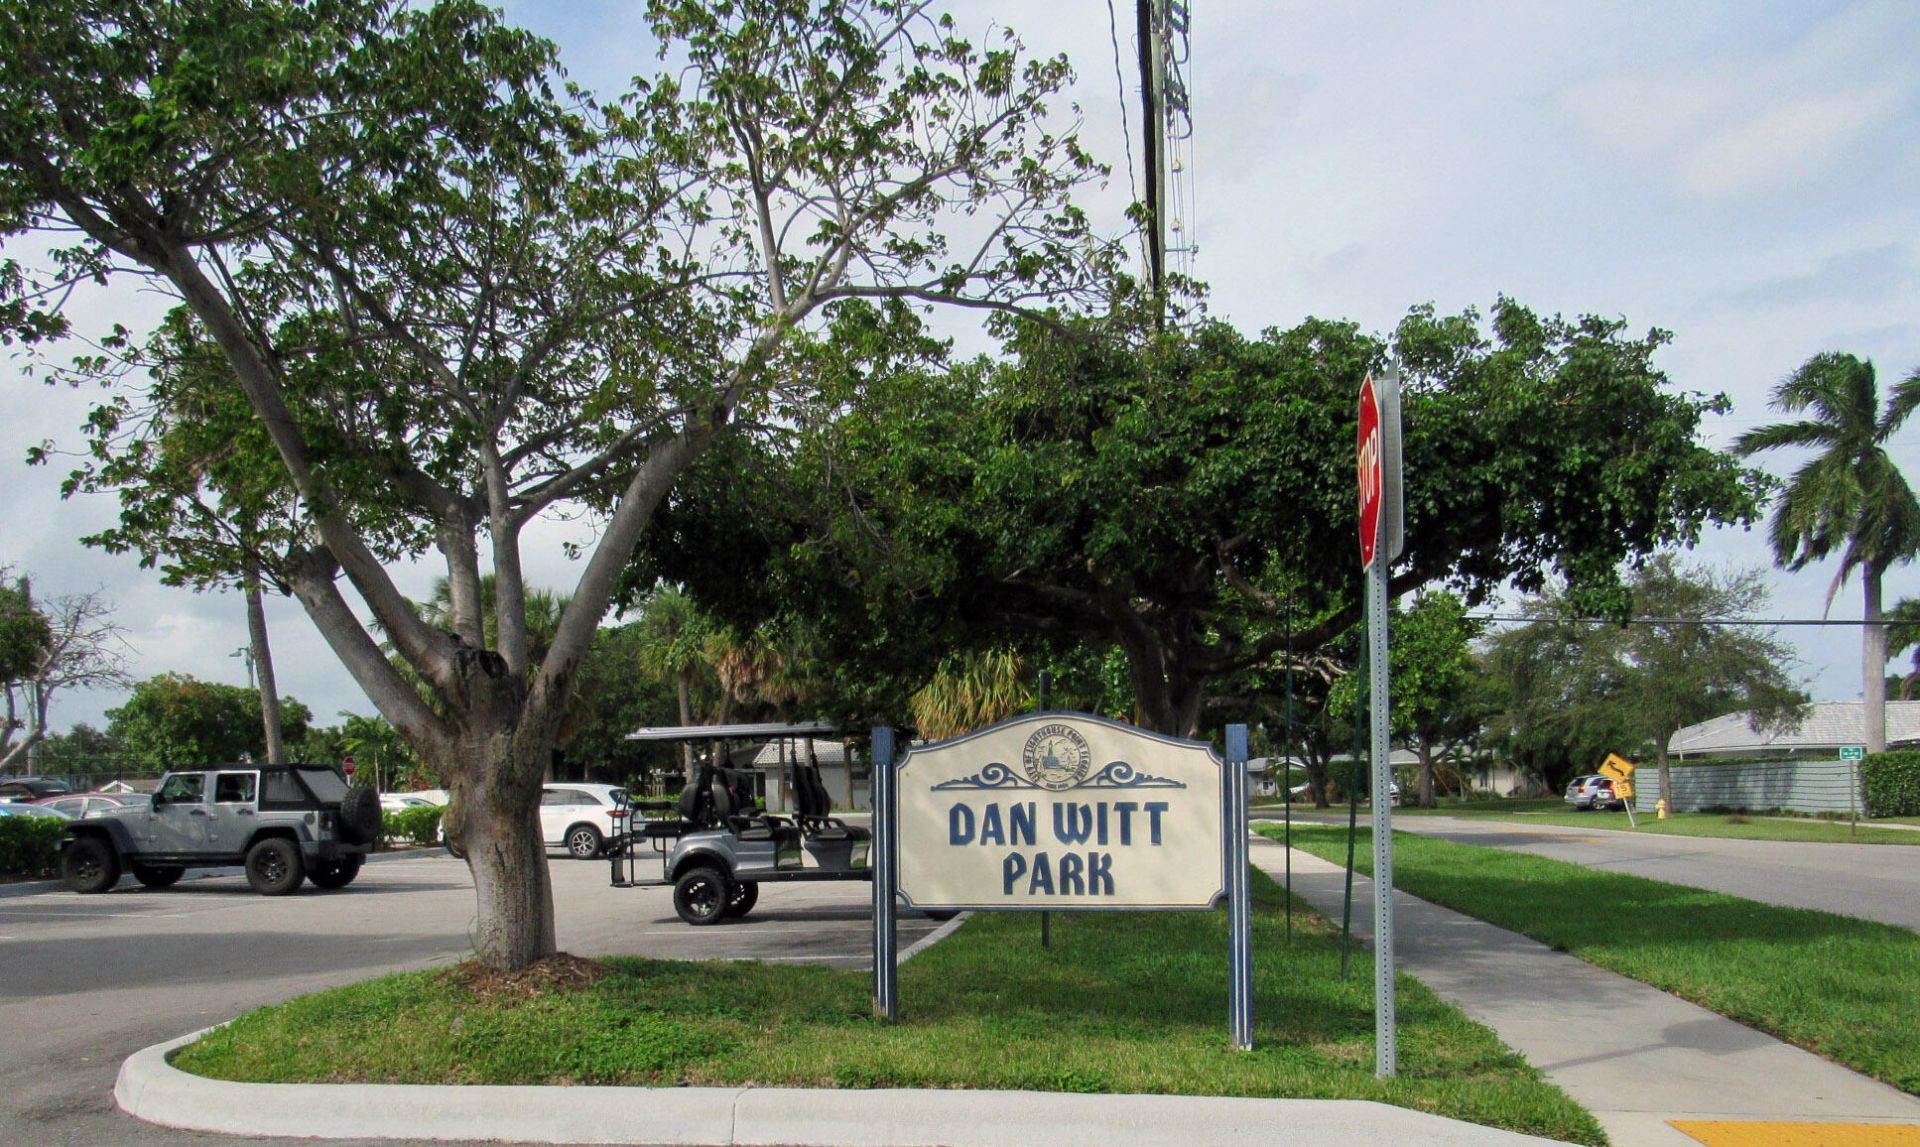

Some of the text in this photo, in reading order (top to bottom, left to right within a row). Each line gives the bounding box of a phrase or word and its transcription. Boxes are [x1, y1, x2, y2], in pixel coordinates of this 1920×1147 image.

[1358, 427, 1377, 518] STOP
[1025, 727, 1065, 752] LIGHTHOUSE
[1067, 730, 1086, 749] POINT
[1026, 766, 1040, 782] CITY
[1072, 751, 1088, 783] FLORIDA
[949, 802, 1169, 846] DAN WITT
[1003, 851, 1115, 896] PARK
